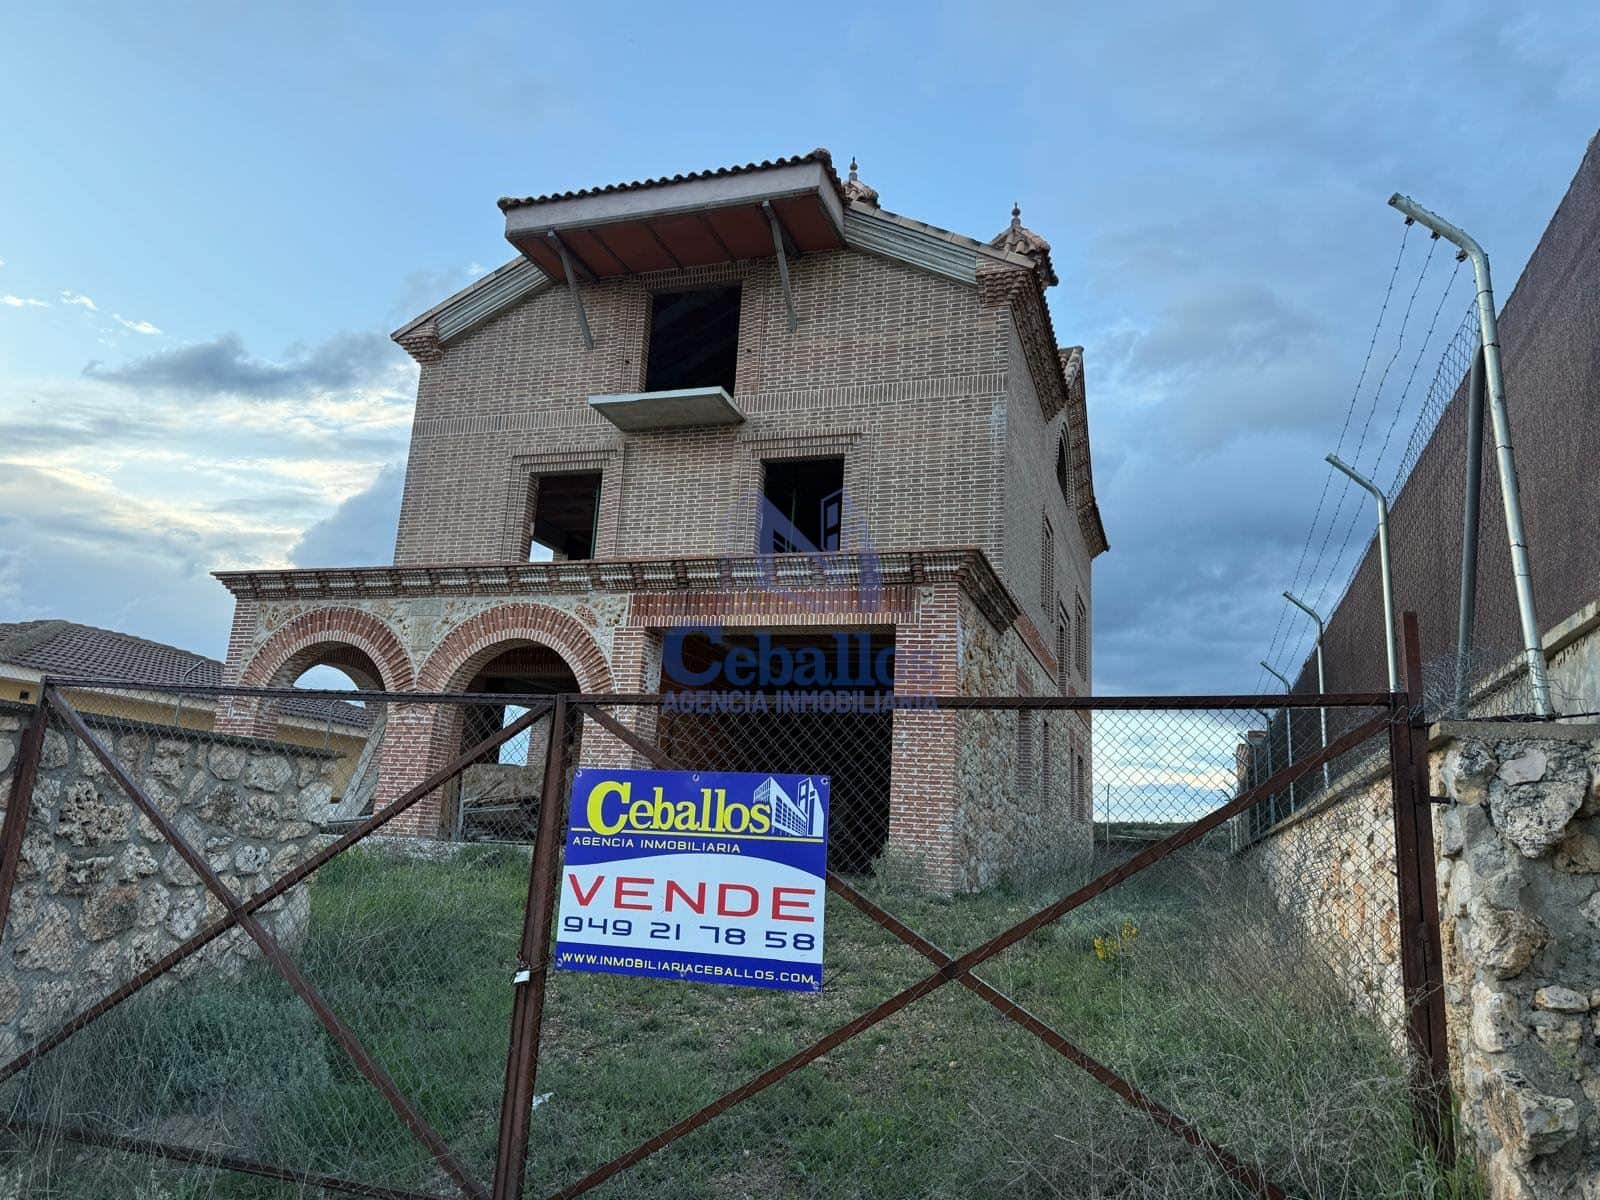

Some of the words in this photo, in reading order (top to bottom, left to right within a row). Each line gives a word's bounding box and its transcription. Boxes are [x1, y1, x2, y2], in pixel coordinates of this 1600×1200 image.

[586, 780, 772, 835] Ceballos
[572, 836, 634, 849] AGENCIA
[640, 839, 741, 854] INMOBILIARIA
[567, 873, 816, 923] VENDE
[563, 916, 633, 937] 949
[650, 922, 681, 941] 21
[699, 925, 746, 945] 78
[765, 931, 815, 951] 58
[562, 952, 815, 985] WWW.INMOBILIARIACEBALLOS.COM
